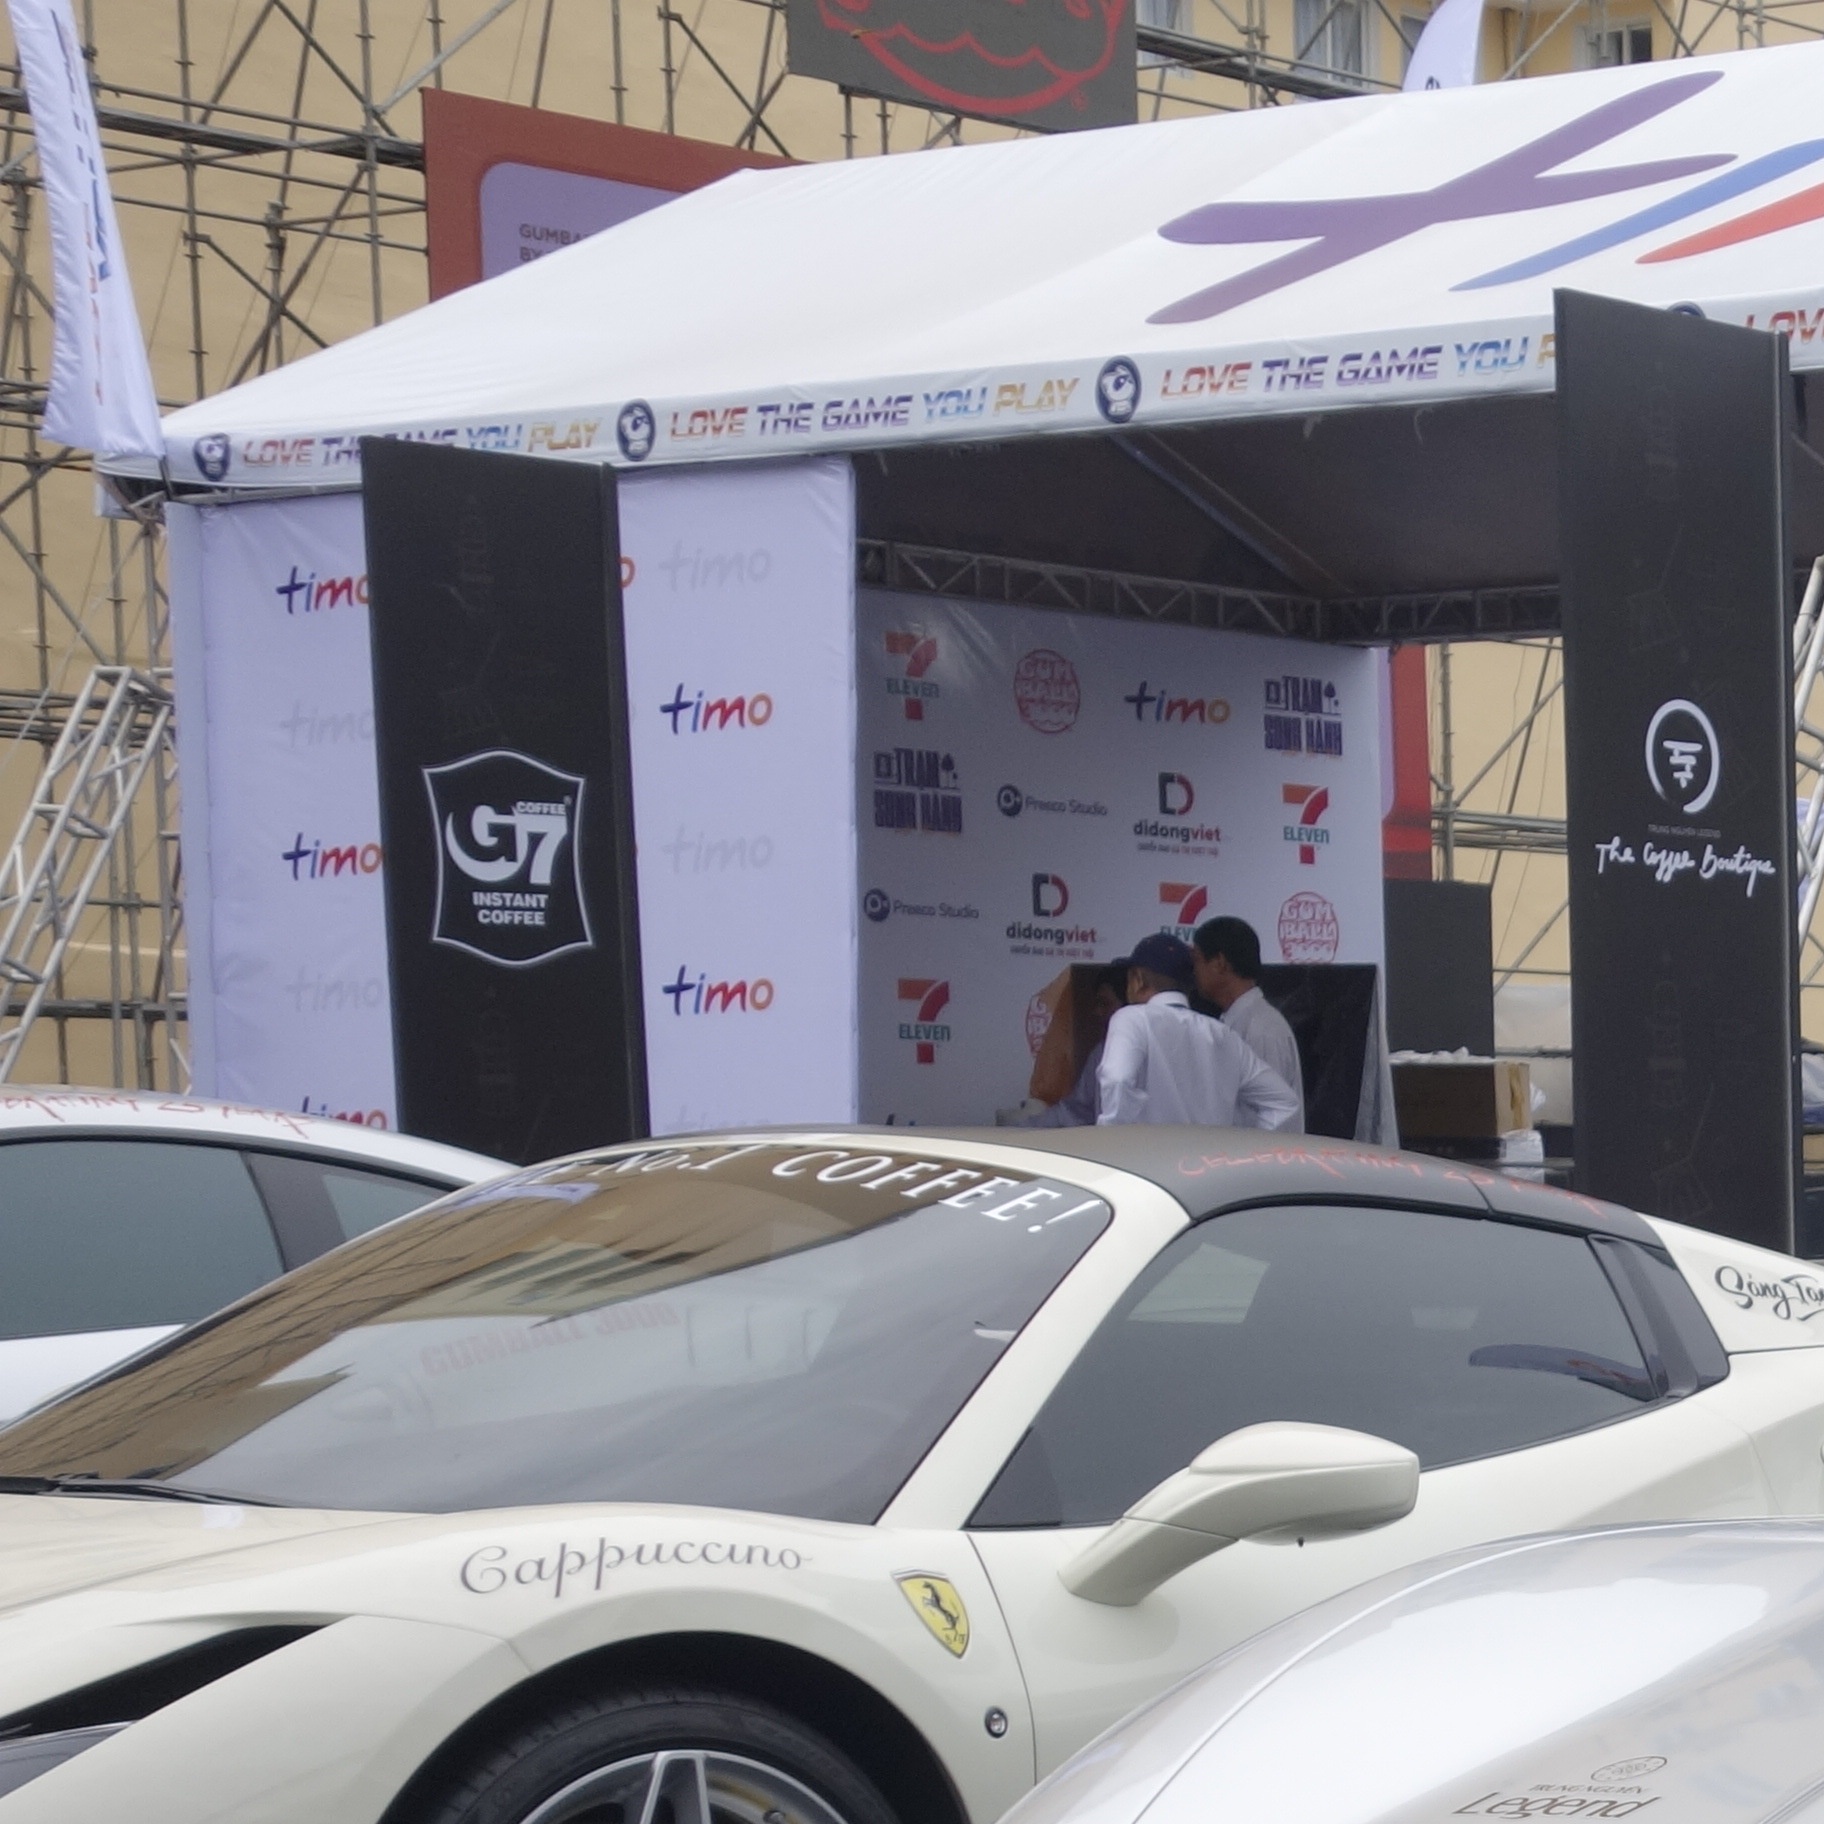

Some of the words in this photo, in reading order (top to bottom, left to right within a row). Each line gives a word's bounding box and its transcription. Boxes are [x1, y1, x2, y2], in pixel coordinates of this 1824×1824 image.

[1160, 361, 1252, 399] LOVE
[1261, 355, 1328, 393] THE
[1336, 345, 1443, 385] GAME
[1454, 336, 1530, 379] YOU
[669, 406, 748, 440] LOVE
[756, 402, 813, 437] THE
[821, 395, 913, 432] GAME
[922, 387, 987, 420] YOU
[992, 376, 1081, 417] PLAY
[242, 437, 315, 467] LOVE
[321, 436, 363, 467] TH
[465, 423, 523, 450] YOU
[528, 417, 601, 453] PLAY
[659, 683, 773, 735] timo
[1124, 681, 1231, 725] timo
[445, 804, 569, 885] G7
[1133, 818, 1222, 844] didongviet
[1595, 835, 1636, 875] The
[1643, 841, 1696, 883] Coffee
[472, 891, 549, 908] INSTANT
[477, 909, 546, 926] COFFEE
[1006, 922, 1098, 946] didongviet
[662, 965, 774, 1016] timo
[771, 1148, 1104, 1235] COFFEE!
[459, 1535, 814, 1599] Cappuccino
[1451, 1791, 1663, 1821] Legend
